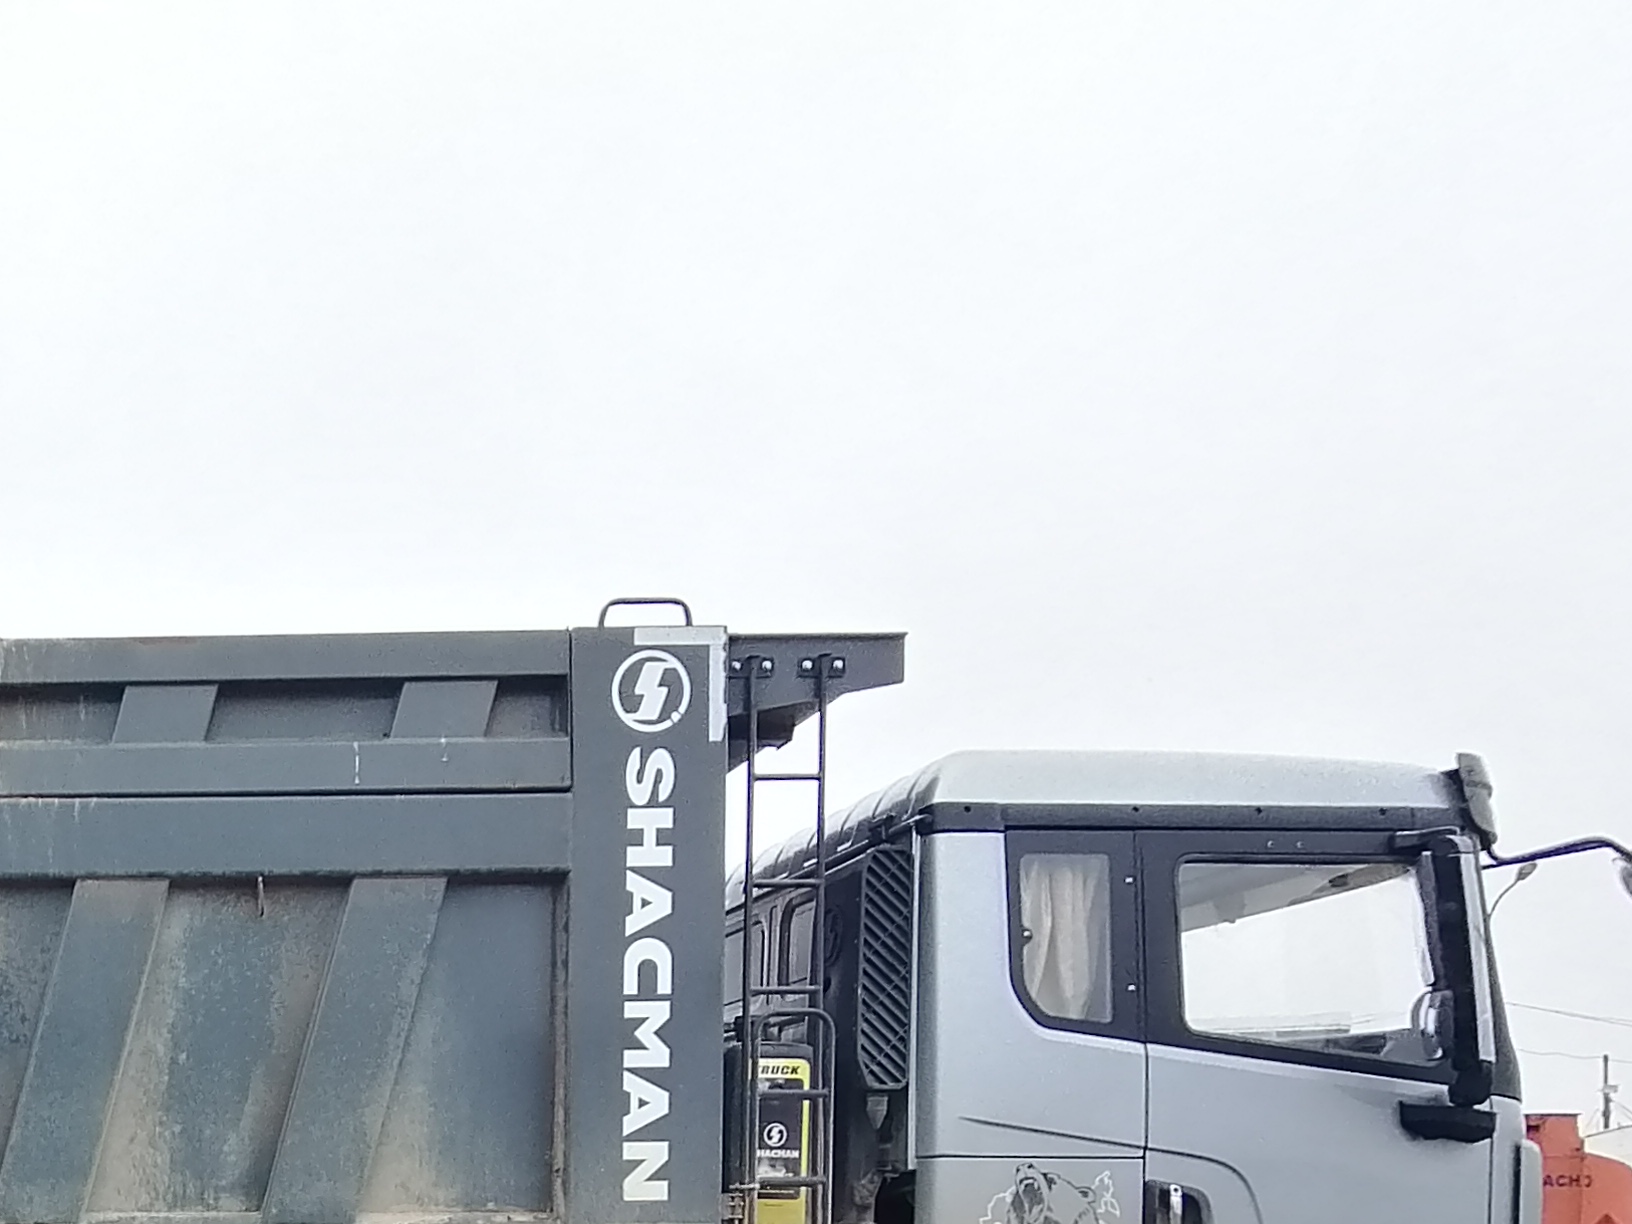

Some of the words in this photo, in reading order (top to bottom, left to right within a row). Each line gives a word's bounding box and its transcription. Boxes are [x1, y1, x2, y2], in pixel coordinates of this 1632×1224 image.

[622, 746, 675, 1201] SHACMAN
[758, 1064, 800, 1075] RUCK
[757, 1149, 799, 1158] HACMAN
